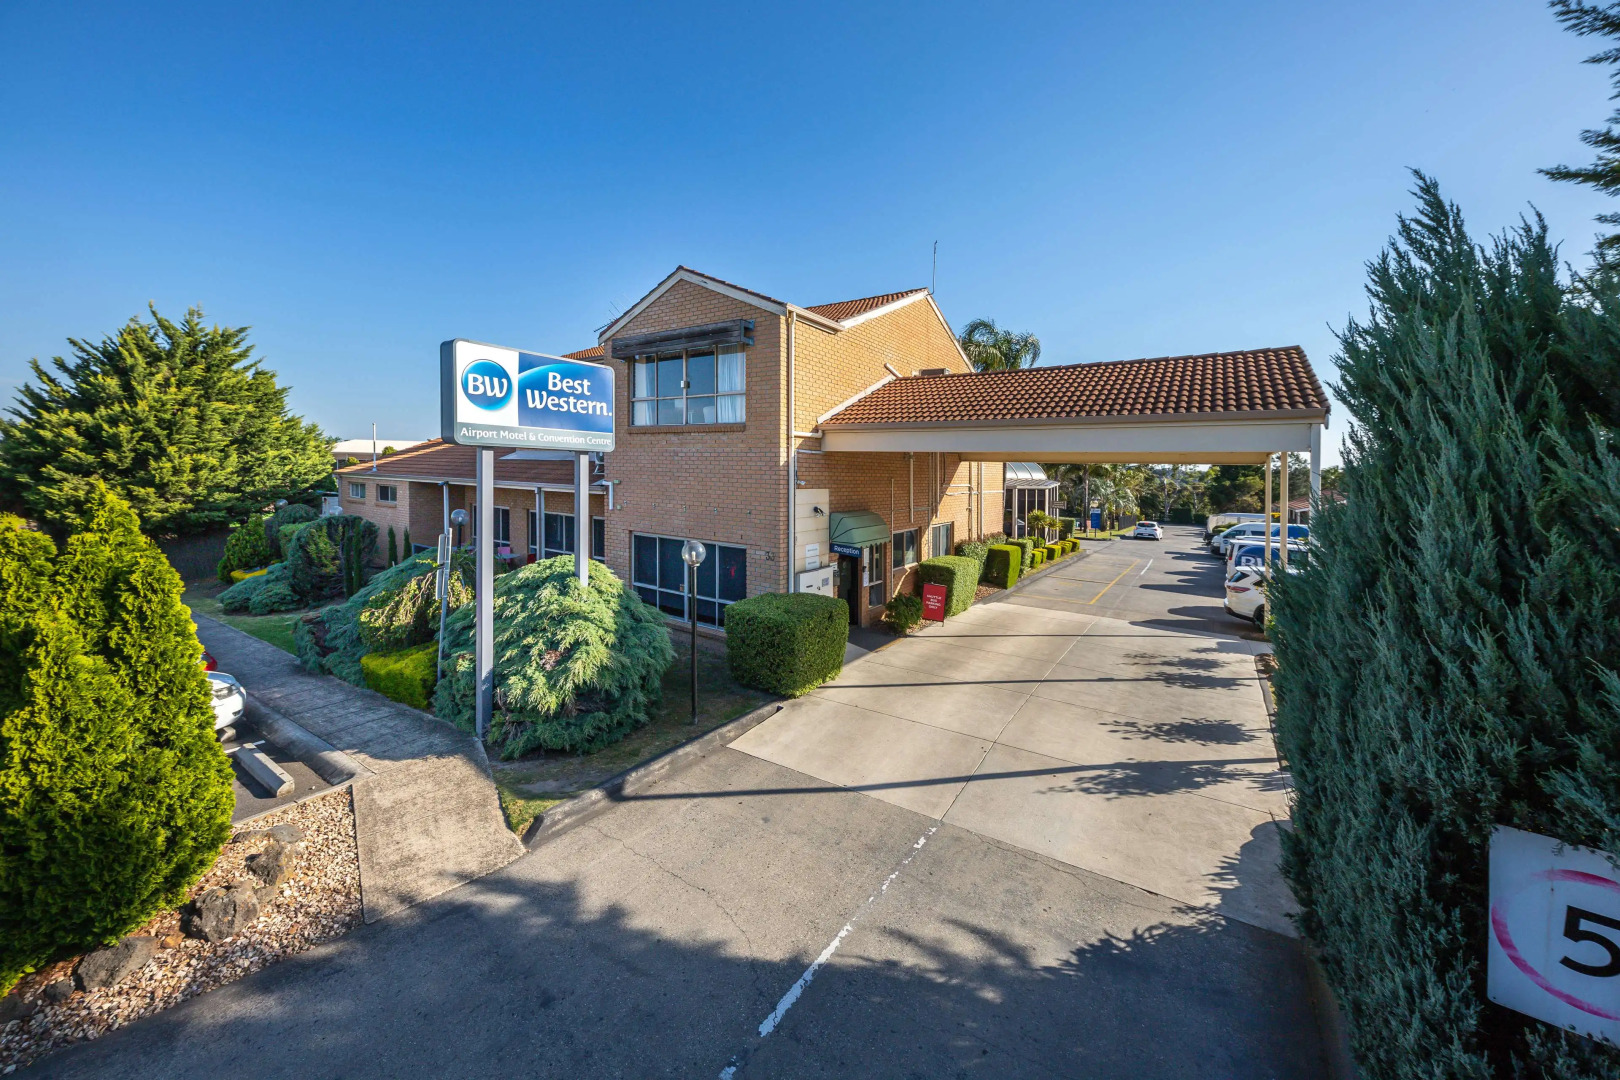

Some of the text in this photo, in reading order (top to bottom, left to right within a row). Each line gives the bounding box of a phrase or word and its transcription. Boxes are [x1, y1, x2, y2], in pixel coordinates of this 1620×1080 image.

[467, 373, 508, 398] BW
[548, 371, 591, 396] Best
[460, 427, 612, 446] Airport Motel & Convention Centre
[833, 545, 860, 556] Reception
[1559, 904, 1620, 978] 5
